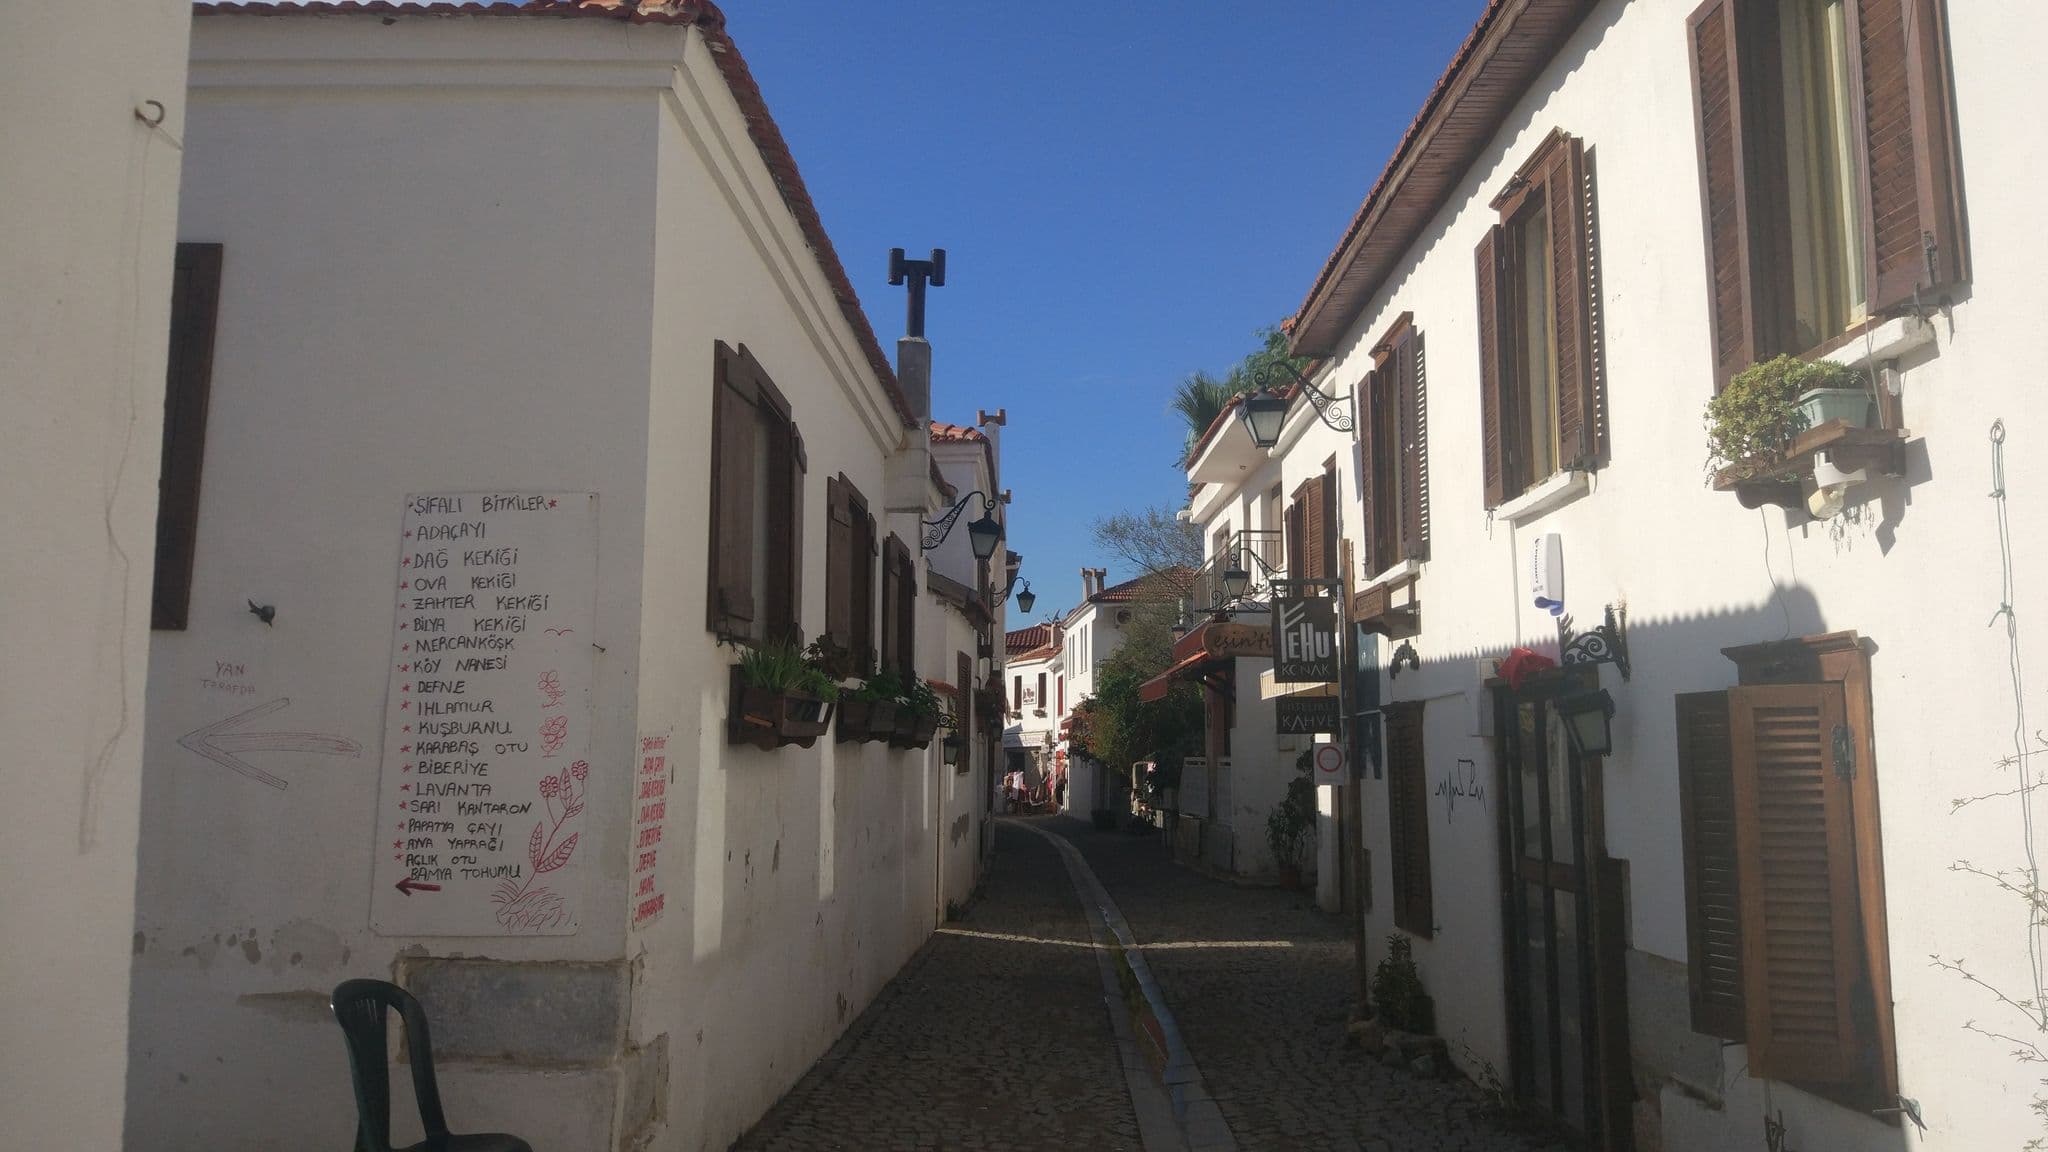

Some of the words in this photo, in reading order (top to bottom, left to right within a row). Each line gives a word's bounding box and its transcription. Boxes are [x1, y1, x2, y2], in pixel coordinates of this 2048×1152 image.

[414, 496, 462, 516] ŞİFALI
[482, 494, 548, 513] BİTKİLER
[417, 521, 486, 541] ADAÇAYI
[413, 548, 449, 569] DAĞ
[463, 548, 518, 566] KEKİĞİ
[414, 576, 447, 591] OVA
[412, 594, 476, 610] ZAHTER
[496, 594, 549, 611] KEKİĞİ
[413, 616, 445, 632] BİLYA
[474, 614, 526, 633] KEKİĞİ
[1279, 601, 1330, 663] FEHU
[215, 660, 244, 677] YAN
[414, 658, 441, 674] KÖY
[455, 655, 507, 672] NANESİ
[1281, 663, 1329, 677] KONAK
[418, 681, 465, 694] DEFNE
[418, 700, 494, 716] IHLAMUR
[418, 721, 512, 738] KUŞBURNU
[1282, 714, 1335, 731] KAHVE
[416, 741, 479, 756] KARABAŞ
[495, 743, 528, 755] OTU
[418, 759, 488, 776] BİBERİYE
[416, 782, 491, 796] LAVANTA
[410, 800, 441, 814] SARI
[458, 801, 532, 816] KANTARON
[408, 818, 454, 833] PAPATYA
[467, 822, 502, 836] ÇAYI
[447, 837, 503, 852] YAPRAĞI
[451, 855, 477, 865] OTU
[411, 866, 452, 881] BAMYA
[460, 864, 521, 880] TOHUMU
